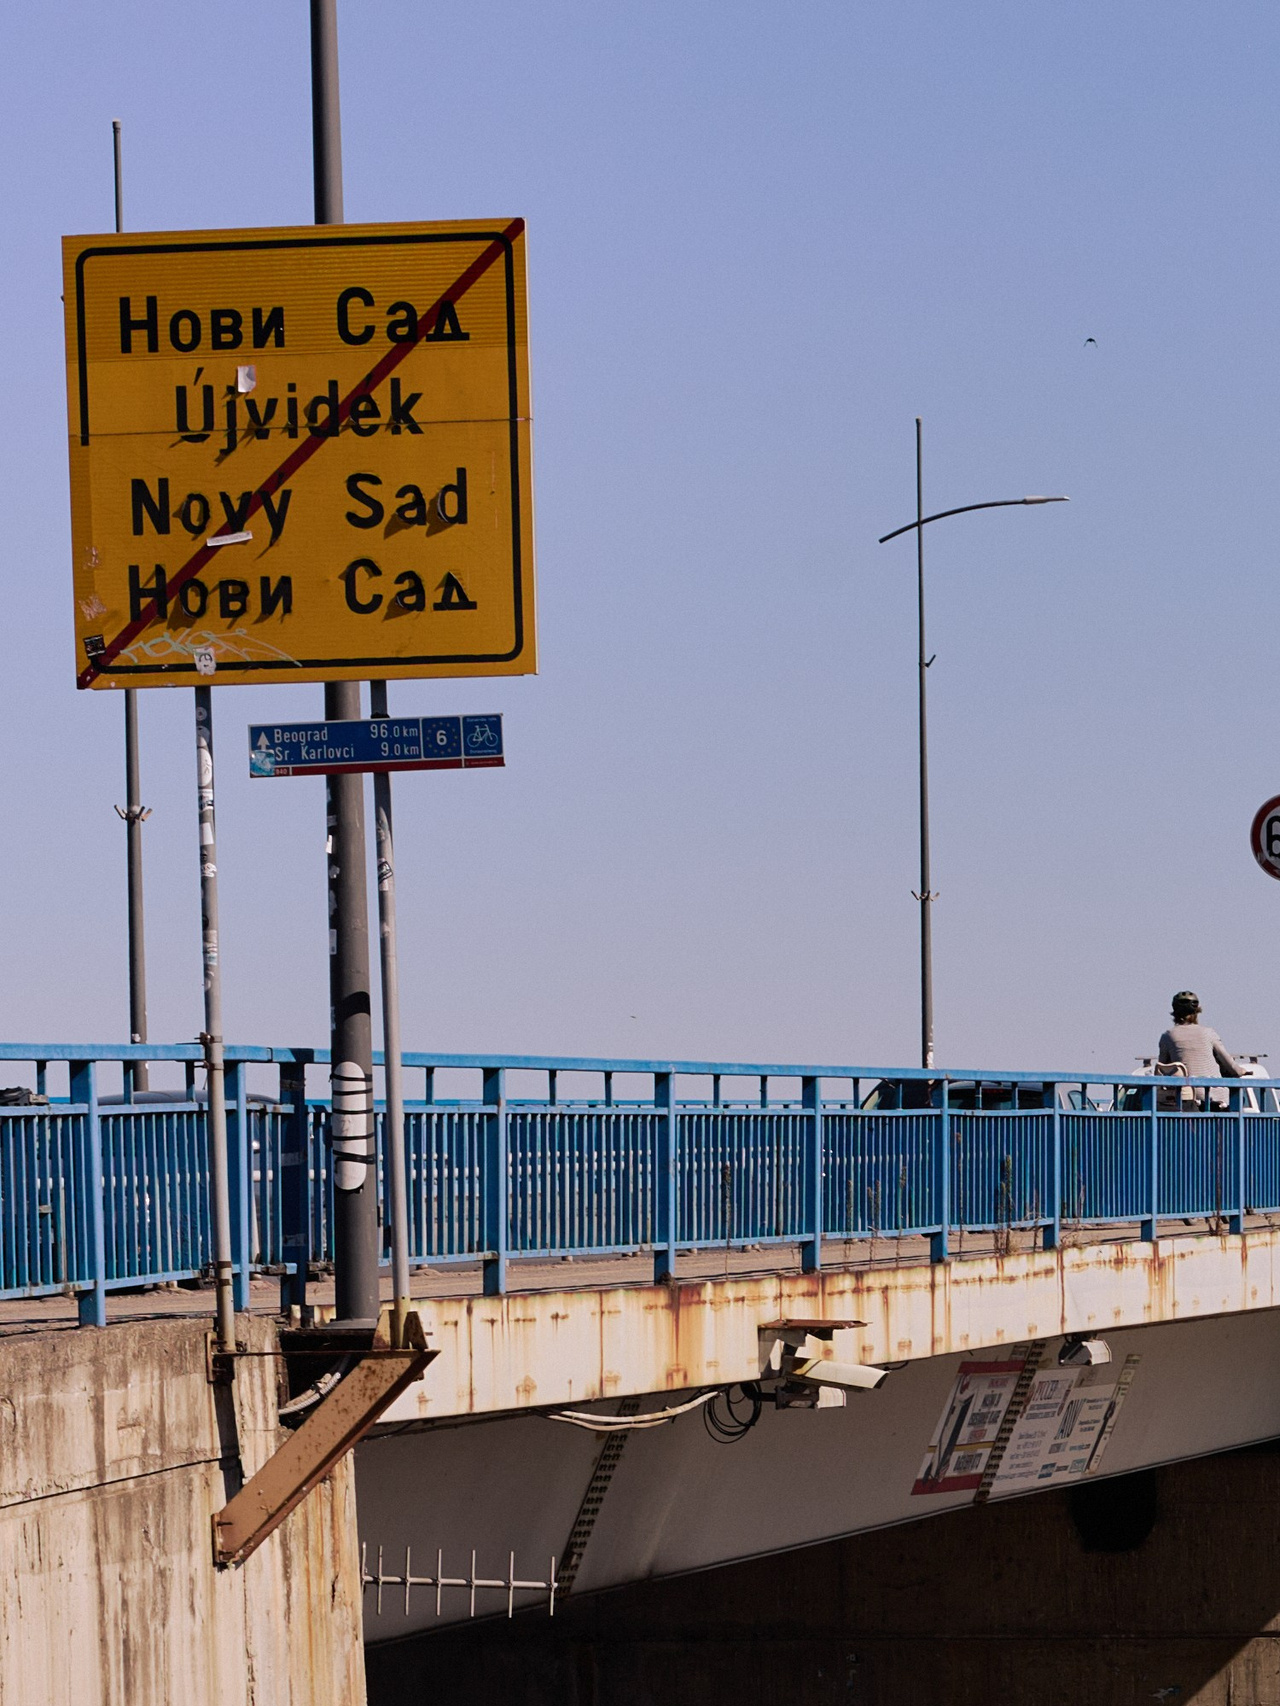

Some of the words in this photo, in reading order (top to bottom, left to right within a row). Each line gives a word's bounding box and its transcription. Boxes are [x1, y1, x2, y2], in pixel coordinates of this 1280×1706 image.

[118, 295, 286, 354] Нови
[335, 286, 471, 346] Сад
[344, 467, 469, 531] Sad
[128, 563, 293, 623] Нови
[344, 557, 478, 616] Сад
[273, 727, 329, 745] Beograd
[370, 723, 401, 739] 96.0
[403, 725, 419, 737] km
[275, 747, 295, 762] Sr.
[301, 744, 355, 761] Karlovci
[380, 742, 401, 757] 9.0
[403, 743, 420, 756] km
[436, 730, 448, 746] 6
